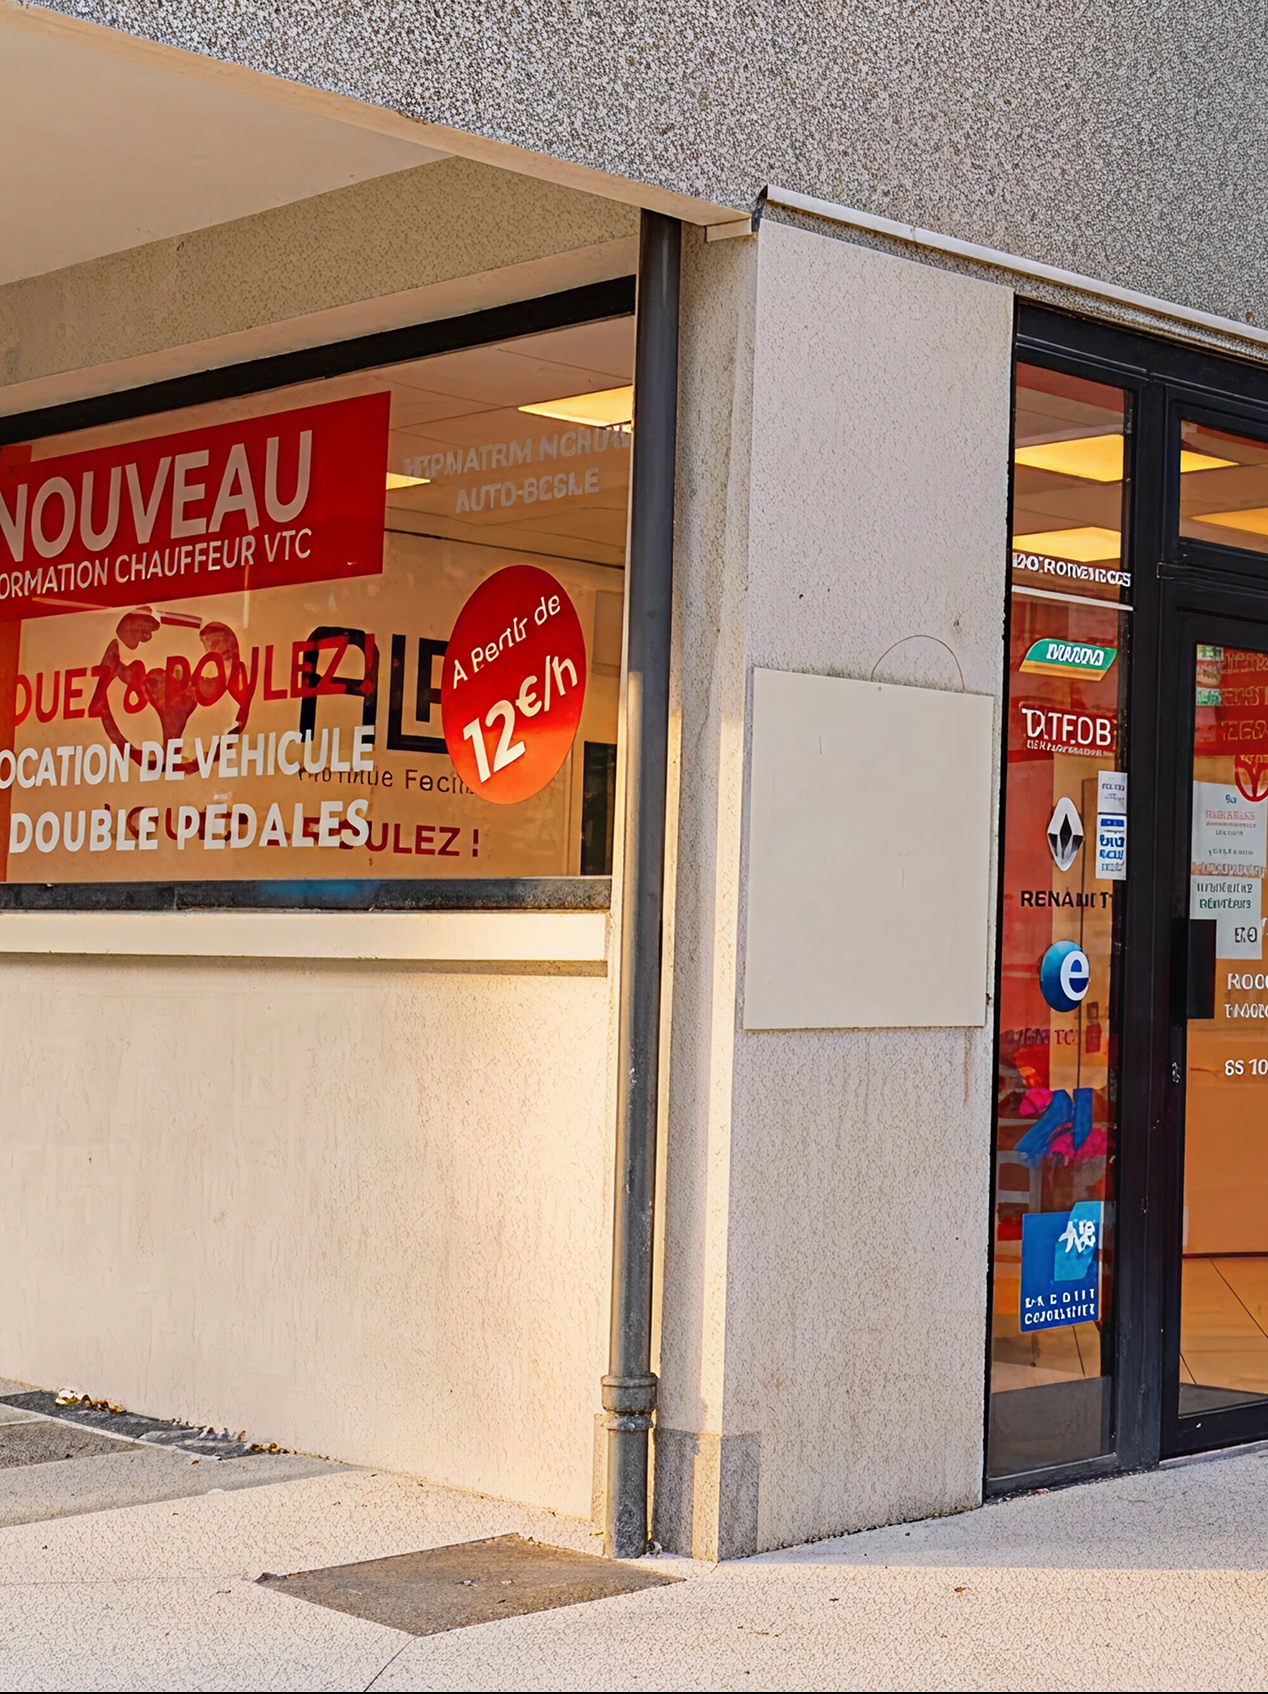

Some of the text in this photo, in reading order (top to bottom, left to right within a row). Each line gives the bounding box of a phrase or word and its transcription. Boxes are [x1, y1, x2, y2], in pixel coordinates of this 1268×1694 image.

[0, 430, 312, 562] NOUVEAU
[115, 534, 256, 583] CHAUFFEUR
[264, 528, 312, 562] VTC
[534, 595, 560, 626] de
[139, 738, 185, 782] DE
[9, 807, 158, 854] DOUBLE
